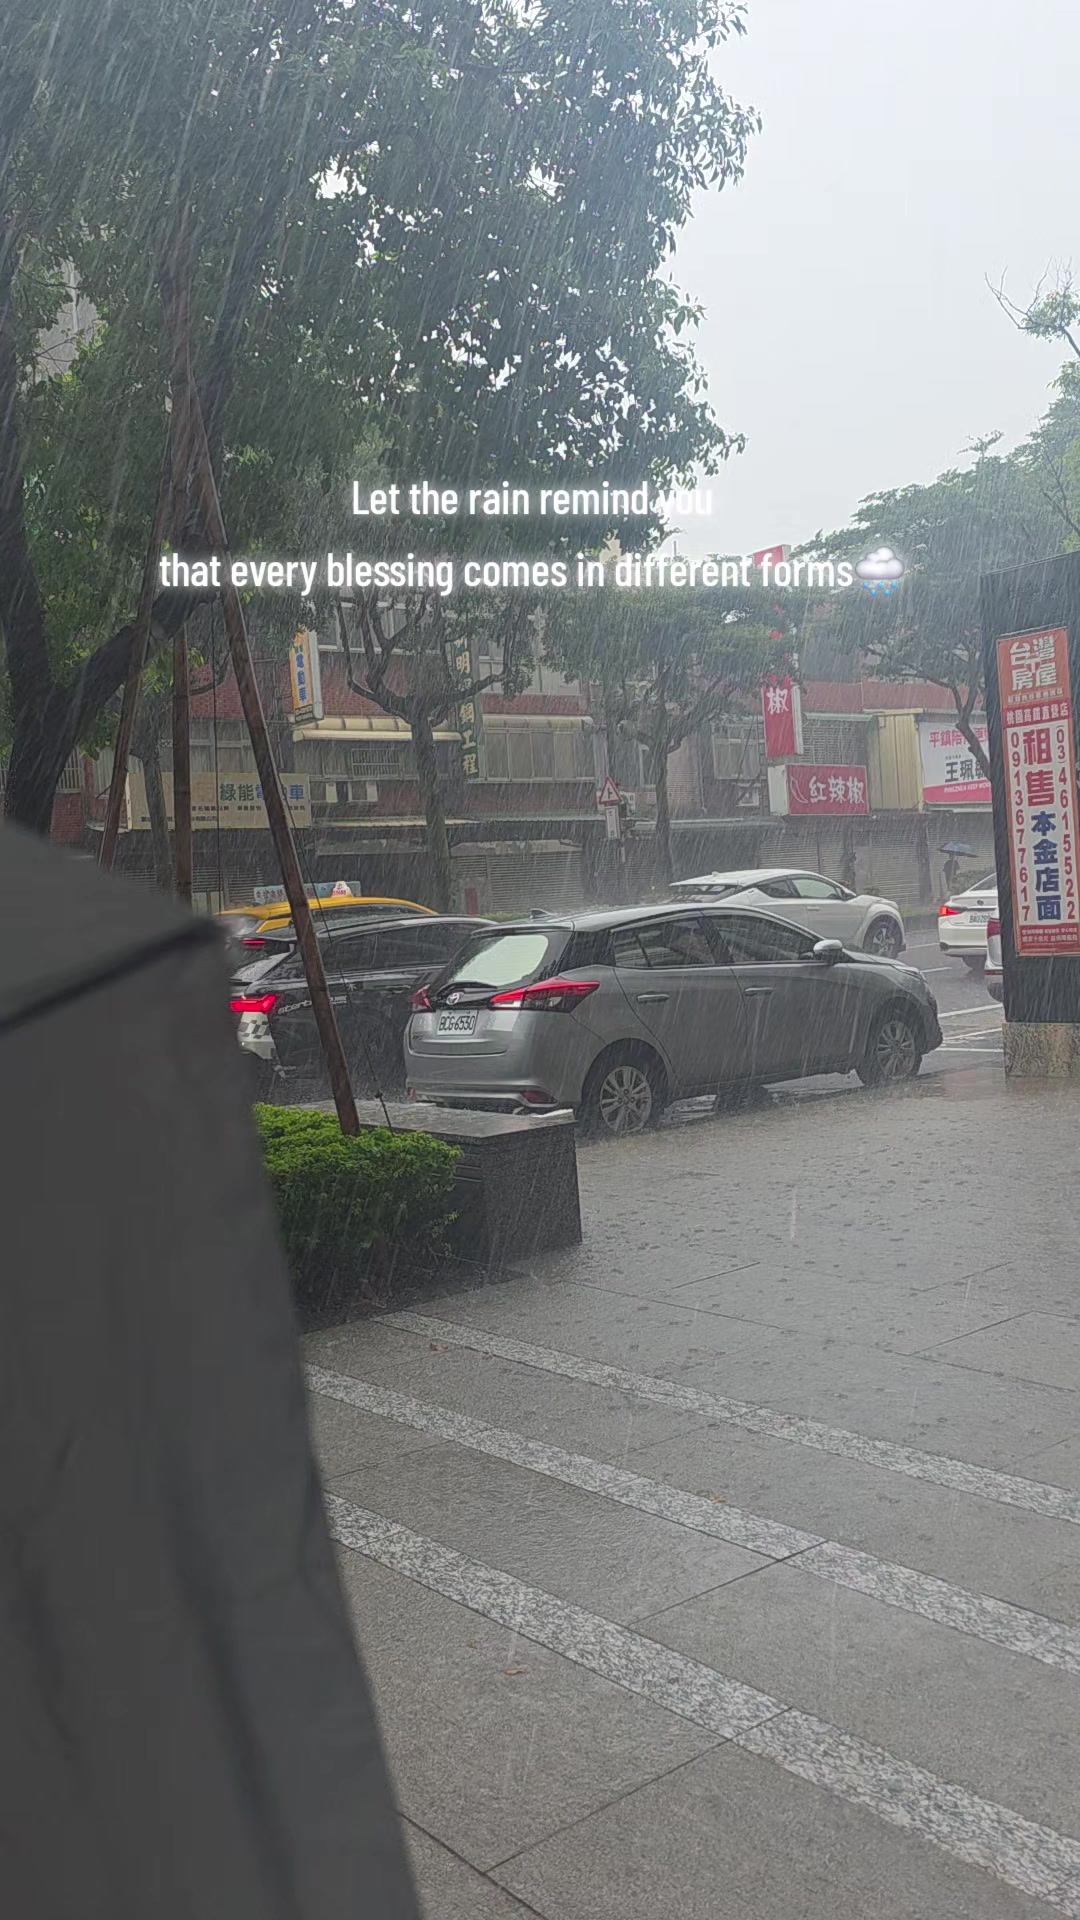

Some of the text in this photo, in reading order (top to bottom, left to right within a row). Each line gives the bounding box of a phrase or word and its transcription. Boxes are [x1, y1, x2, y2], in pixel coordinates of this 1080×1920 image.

[808, 775, 865, 804] 紅辣椒
[1010, 731, 1030, 922] 0913677617
